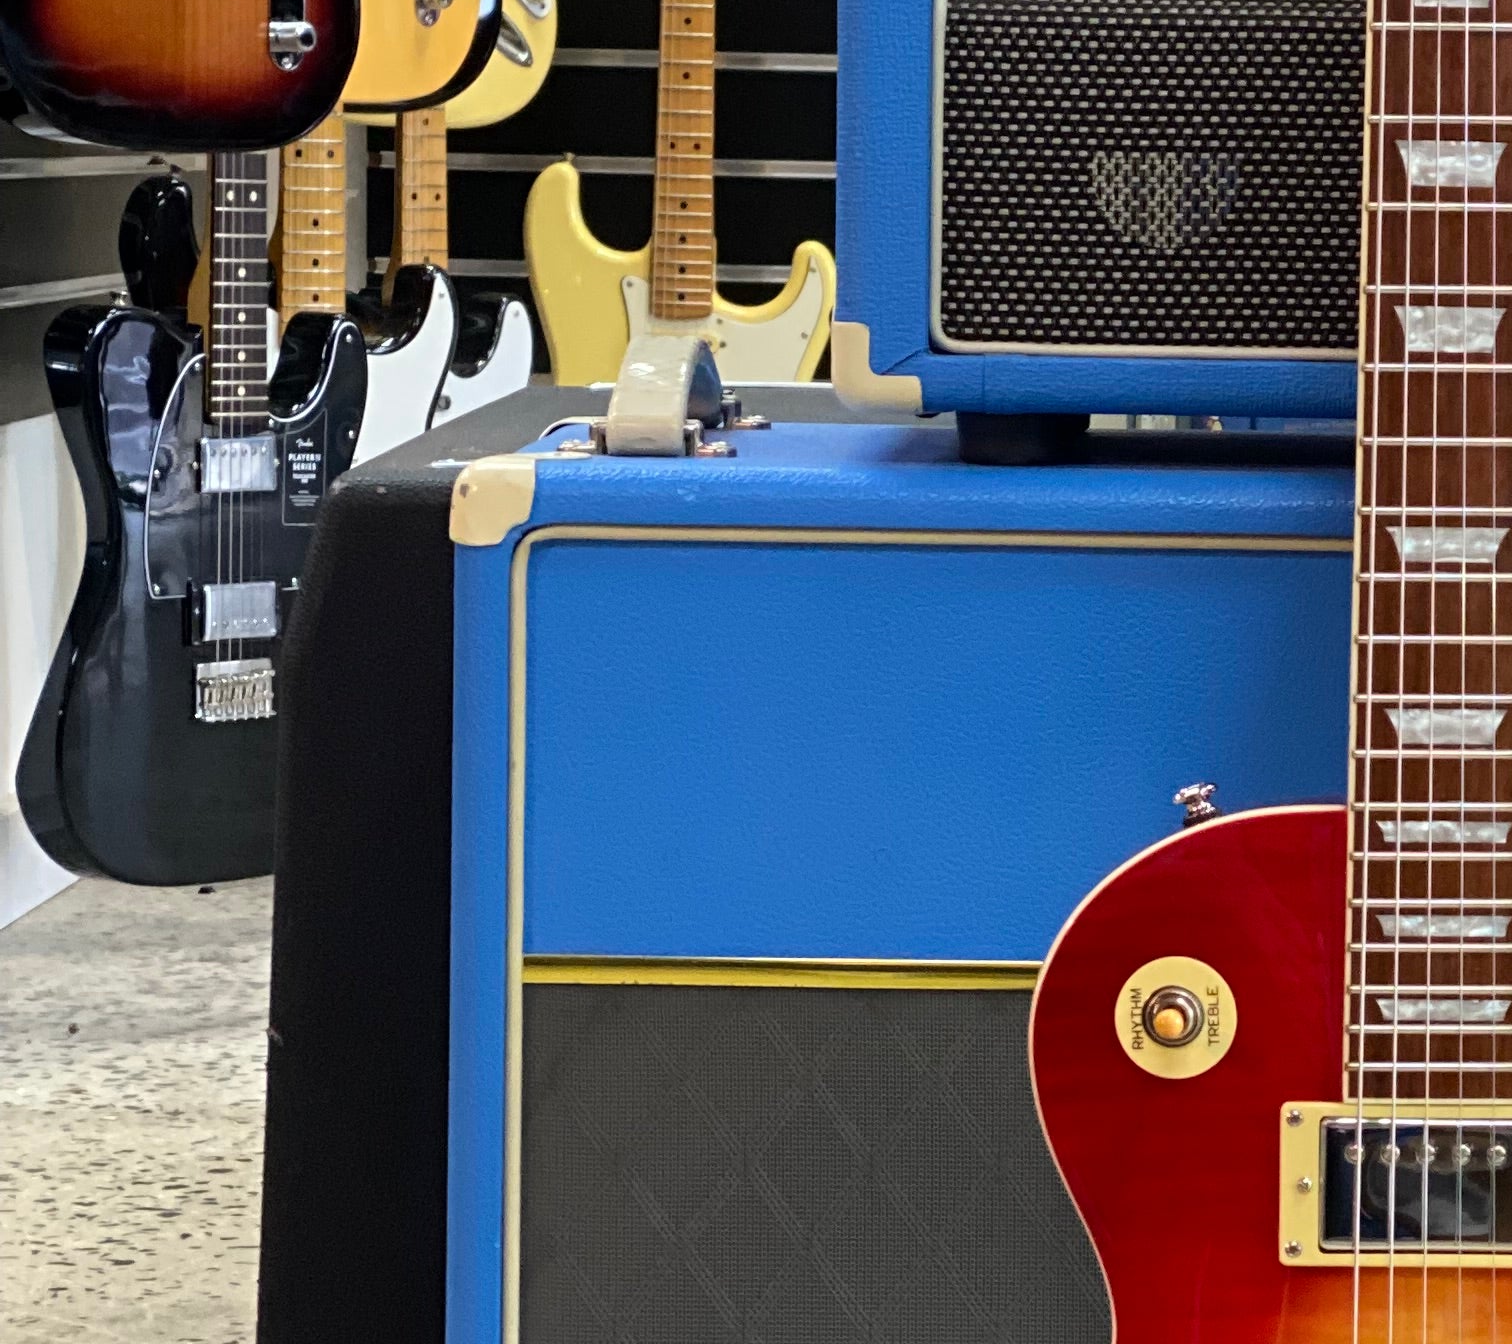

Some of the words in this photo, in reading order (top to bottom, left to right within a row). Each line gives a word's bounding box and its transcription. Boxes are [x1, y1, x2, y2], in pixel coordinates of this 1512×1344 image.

[288, 453, 315, 462] PLAYER
[1130, 987, 1144, 1050] RHYTHM
[1206, 985, 1220, 1047] TREBLE
